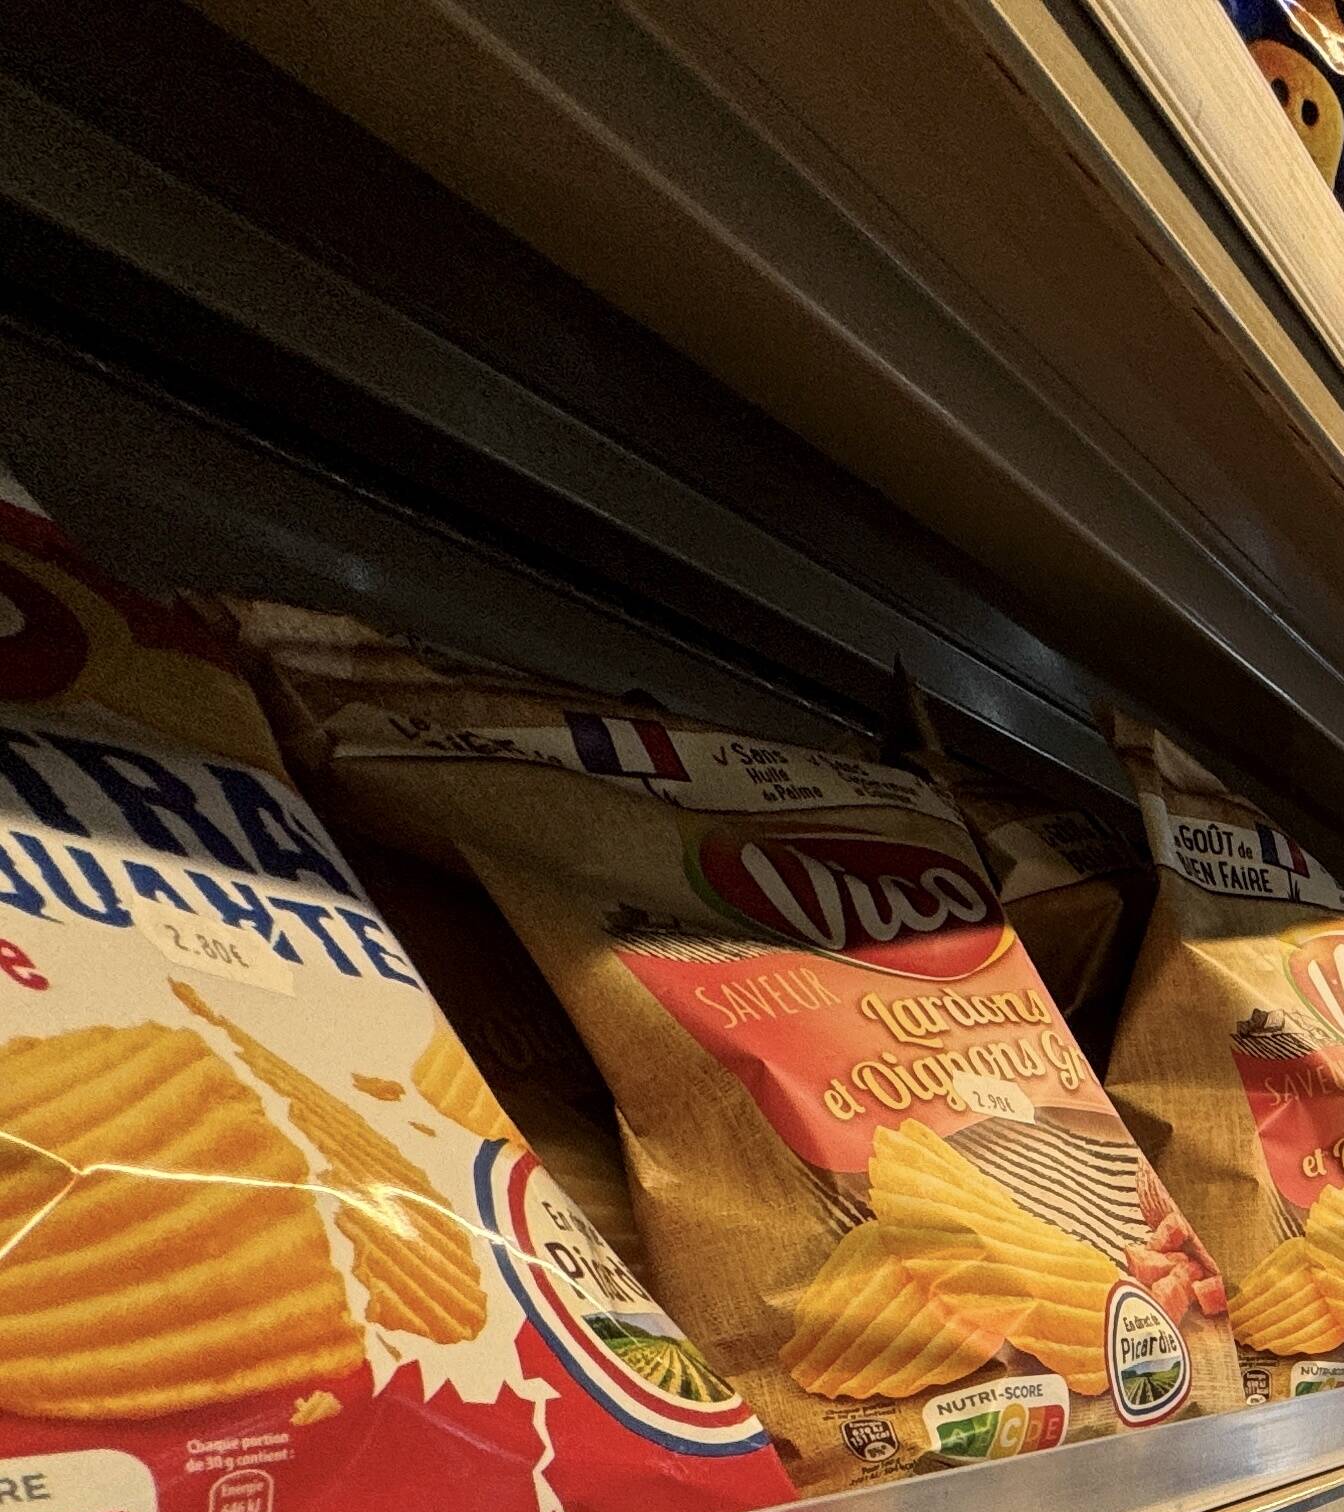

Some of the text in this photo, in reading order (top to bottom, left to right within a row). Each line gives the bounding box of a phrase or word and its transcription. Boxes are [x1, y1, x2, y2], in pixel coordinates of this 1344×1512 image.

[730, 742, 788, 765] Sans
[1179, 823, 1254, 860] GOÛT de
[741, 842, 988, 950] Vico
[695, 968, 841, 1030] SAVEUR
[861, 988, 1051, 1048] Lardons
[824, 1079, 866, 1120] et
[1303, 1148, 1327, 1178] et
[1121, 1335, 1178, 1363] Picardie
[936, 1384, 1043, 1416] NUTRI-SCORE
